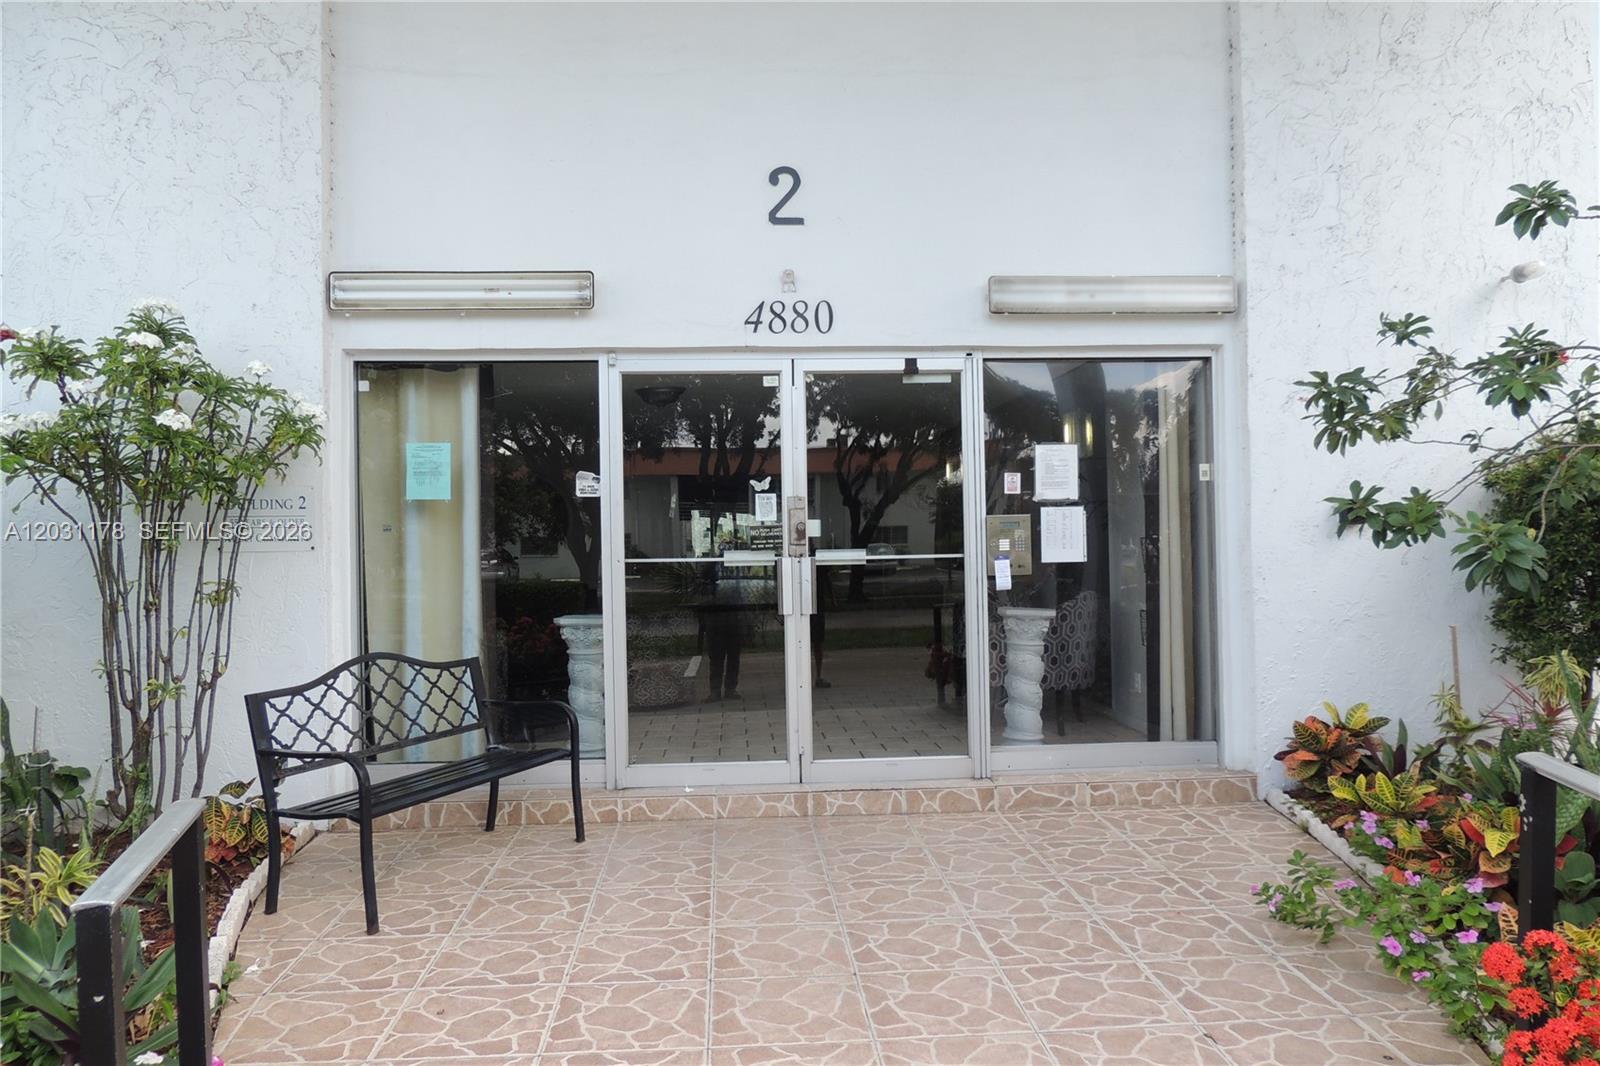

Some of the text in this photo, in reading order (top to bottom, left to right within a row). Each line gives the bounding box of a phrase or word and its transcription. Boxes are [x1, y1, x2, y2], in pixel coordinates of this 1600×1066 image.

[768, 166, 805, 225] 2
[744, 300, 834, 334] 4880
[298, 496, 306, 509] 2
